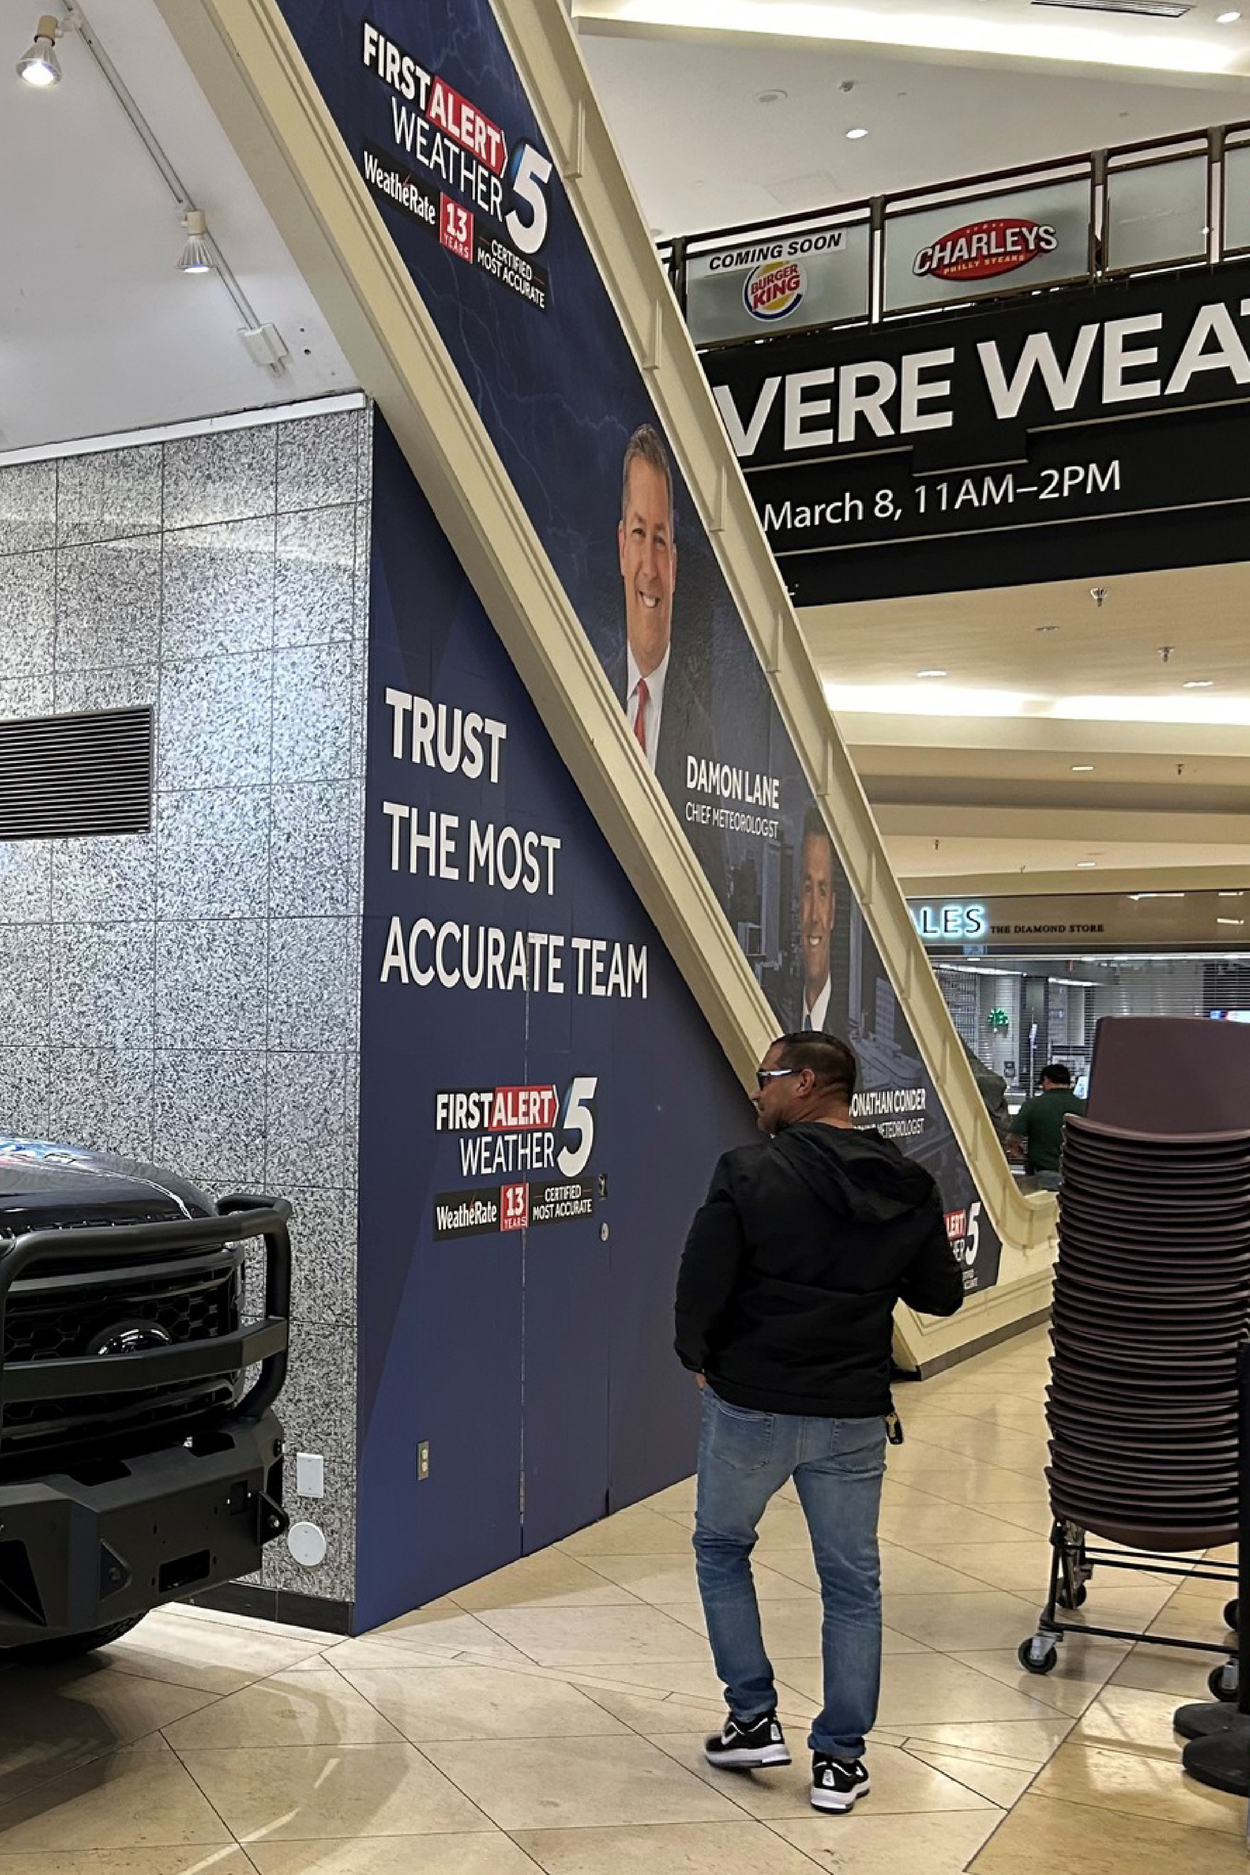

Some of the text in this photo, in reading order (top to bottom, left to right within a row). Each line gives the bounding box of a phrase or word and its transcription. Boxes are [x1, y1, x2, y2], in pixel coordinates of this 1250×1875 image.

[363, 22, 501, 167] FIRST ALERT
[391, 97, 503, 222] WEATHER
[505, 144, 552, 254] 5
[446, 203, 468, 242] 13
[444, 235, 470, 259] YEARS
[491, 240, 532, 280] CERTIFIED
[709, 232, 842, 271] COMING SOON
[913, 226, 1058, 275] CHARLEYS
[944, 255, 1025, 275] PHILLY STEAKS
[478, 248, 545, 309] MOST ACCURATE
[751, 263, 799, 293] BURGER
[752, 278, 801, 308] KING
[713, 298, 1250, 457] VERE WEA
[764, 492, 863, 532] March
[874, 489, 902, 521] 8,
[385, 687, 507, 784] TRUST
[686, 755, 780, 810] DAMON LANE
[685, 801, 779, 838] CHIEF METEOROLOGIST
[383, 801, 561, 896] THE MOST
[911, 905, 1104, 936] LES THE DIAMOND STORE
[380, 915, 647, 999] ACCURATE TEAM
[436, 1090, 552, 1130] FIRST ALERT
[894, 1088, 925, 1113] CONDER
[557, 1077, 598, 1177] 5
[460, 1132, 555, 1176] WEATHER
[506, 1187, 524, 1217] 13
[533, 1199, 592, 1221] MOST ACCURATE
[545, 1185, 582, 1202] CERTIFIED
[504, 1216, 527, 1229] YEARS
[946, 1213, 964, 1237] LERT
[966, 1202, 981, 1265] 5
